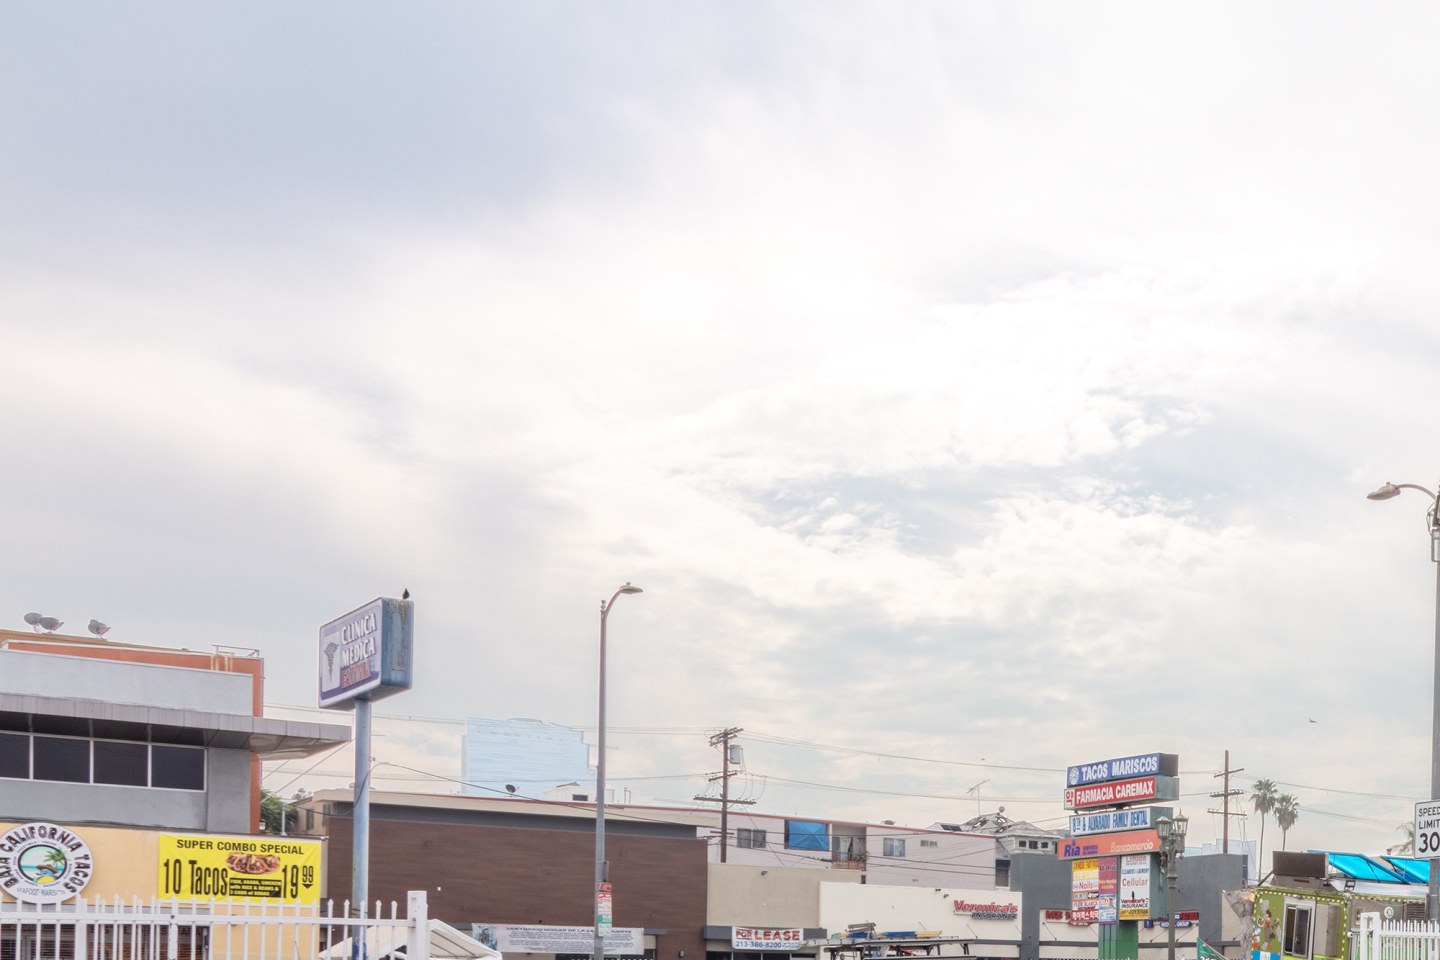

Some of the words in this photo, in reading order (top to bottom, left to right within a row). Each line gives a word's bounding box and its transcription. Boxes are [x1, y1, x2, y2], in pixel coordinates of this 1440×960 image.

[341, 613, 377, 645] CLINICA
[342, 637, 376, 668] MEDICA
[1081, 764, 1108, 781] TACOS
[1111, 756, 1157, 777] MARISCOS
[1076, 786, 1114, 804] FARMACIA
[1115, 780, 1153, 798] CAREMAX
[1088, 814, 1110, 831] ALVARADO
[1112, 811, 1129, 829] FAMILY
[1130, 810, 1148, 826] DENTAL
[1419, 819, 1440, 830] LIMIT
[0, 825, 83, 853] CALIFORNIA
[177, 839, 213, 850] SUPER
[217, 841, 257, 852] COMBO
[260, 843, 304, 855] SPECIAL
[1064, 840, 1080, 857] Ria
[1418, 831, 1440, 853] 30
[63, 854, 91, 893] TACOS
[163, 858, 182, 894] 10
[188, 860, 228, 896] Tacos
[282, 864, 299, 899] 19
[302, 865, 314, 883] 99
[1122, 877, 1148, 887] Cellular
[953, 899, 1018, 913] Veronica's
[971, 912, 1018, 920] INSURANCE
[735, 940, 782, 948] 213-386-8200
[754, 928, 800, 940] LEASE
